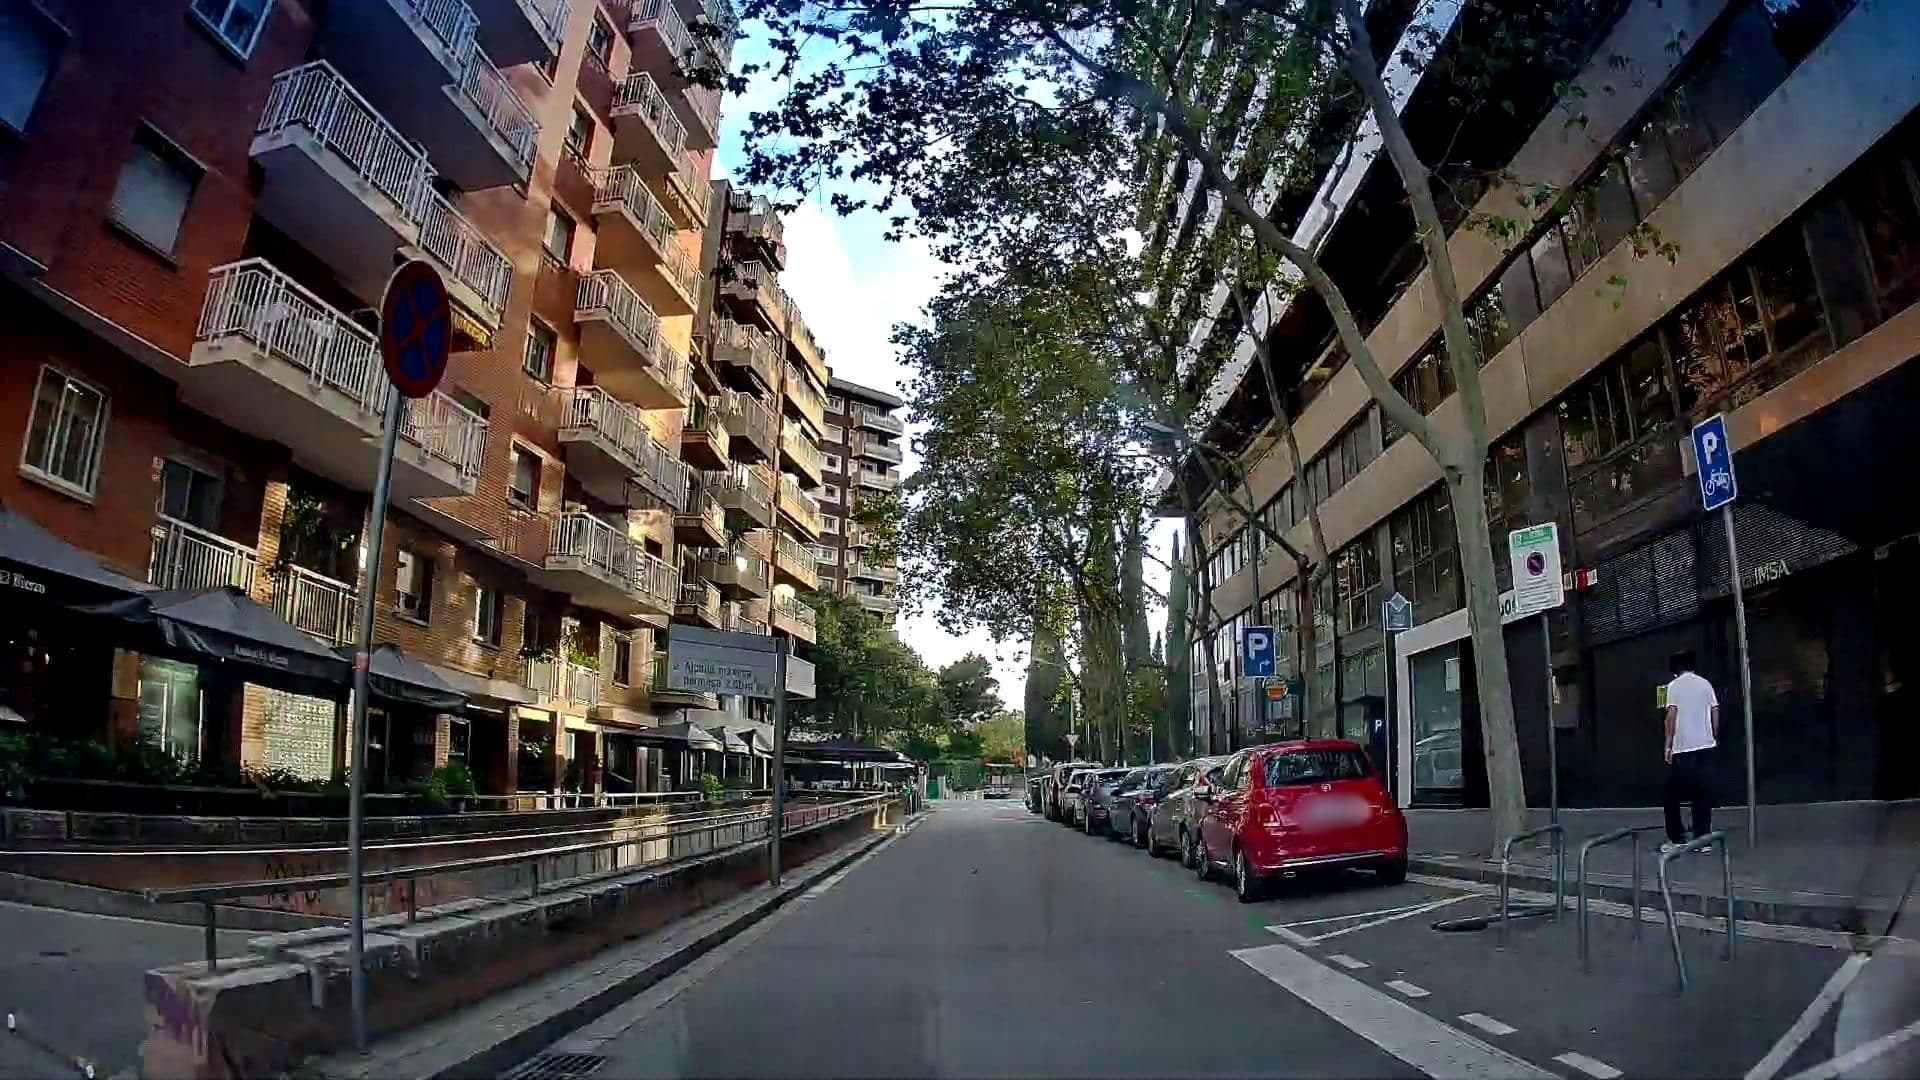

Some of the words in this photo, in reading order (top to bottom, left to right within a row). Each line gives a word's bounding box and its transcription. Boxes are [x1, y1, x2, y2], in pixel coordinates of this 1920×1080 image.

[1702, 431, 1718, 465] P
[1248, 632, 1268, 660] P
[1375, 719, 1383, 731] P
